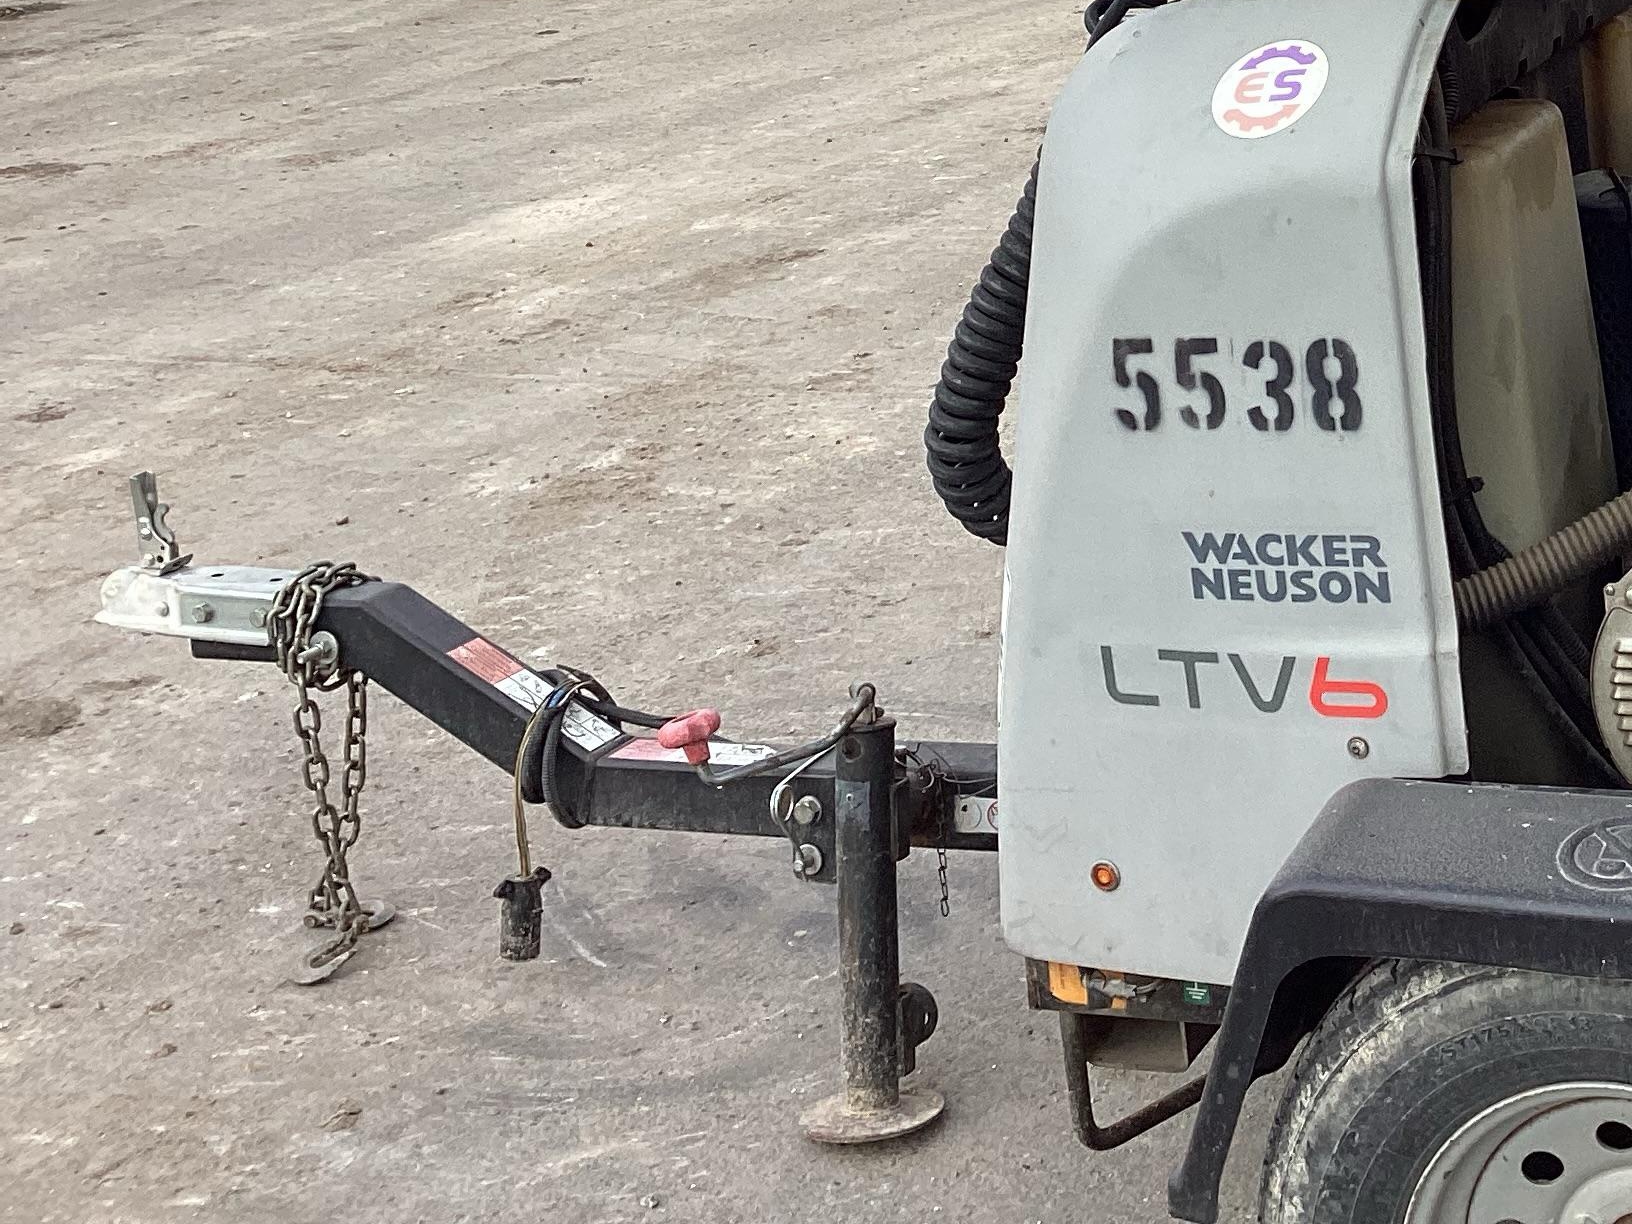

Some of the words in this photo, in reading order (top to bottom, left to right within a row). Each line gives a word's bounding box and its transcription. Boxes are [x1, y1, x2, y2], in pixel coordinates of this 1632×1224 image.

[1234, 69, 1307, 103] ES
[1112, 337, 1363, 432] 5538
[1181, 532, 1388, 567] WACKER
[1191, 567, 1392, 604] NEUSON
[1100, 645, 1389, 718] LTV6
